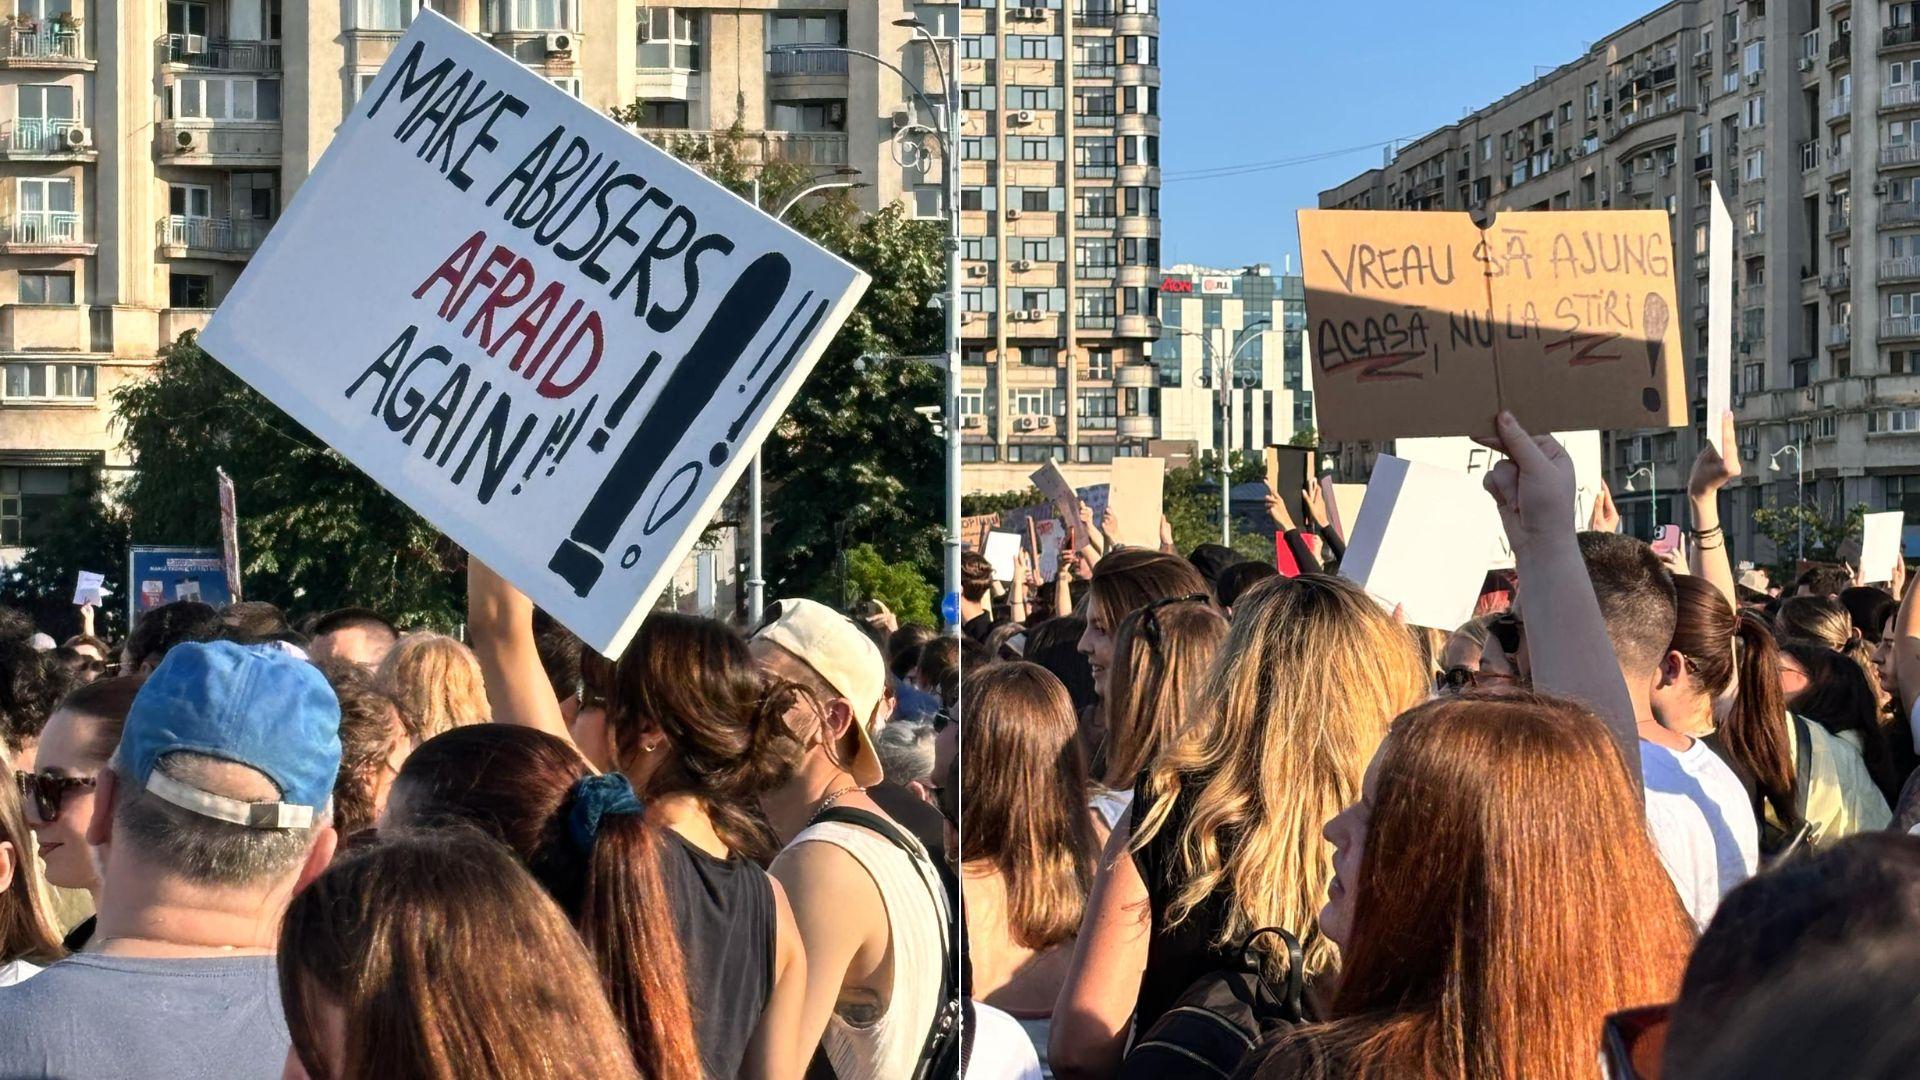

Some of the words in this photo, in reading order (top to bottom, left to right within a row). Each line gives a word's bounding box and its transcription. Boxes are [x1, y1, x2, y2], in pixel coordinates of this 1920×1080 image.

[367, 41, 529, 192] MAKE
[485, 125, 735, 333] ABUSERS
[412, 231, 604, 400] AFRAID
[1321, 244, 1456, 293] VREAU
[1550, 230, 1669, 279] AJUNG
[1449, 308, 1494, 351] NU
[1506, 301, 1541, 341] LA
